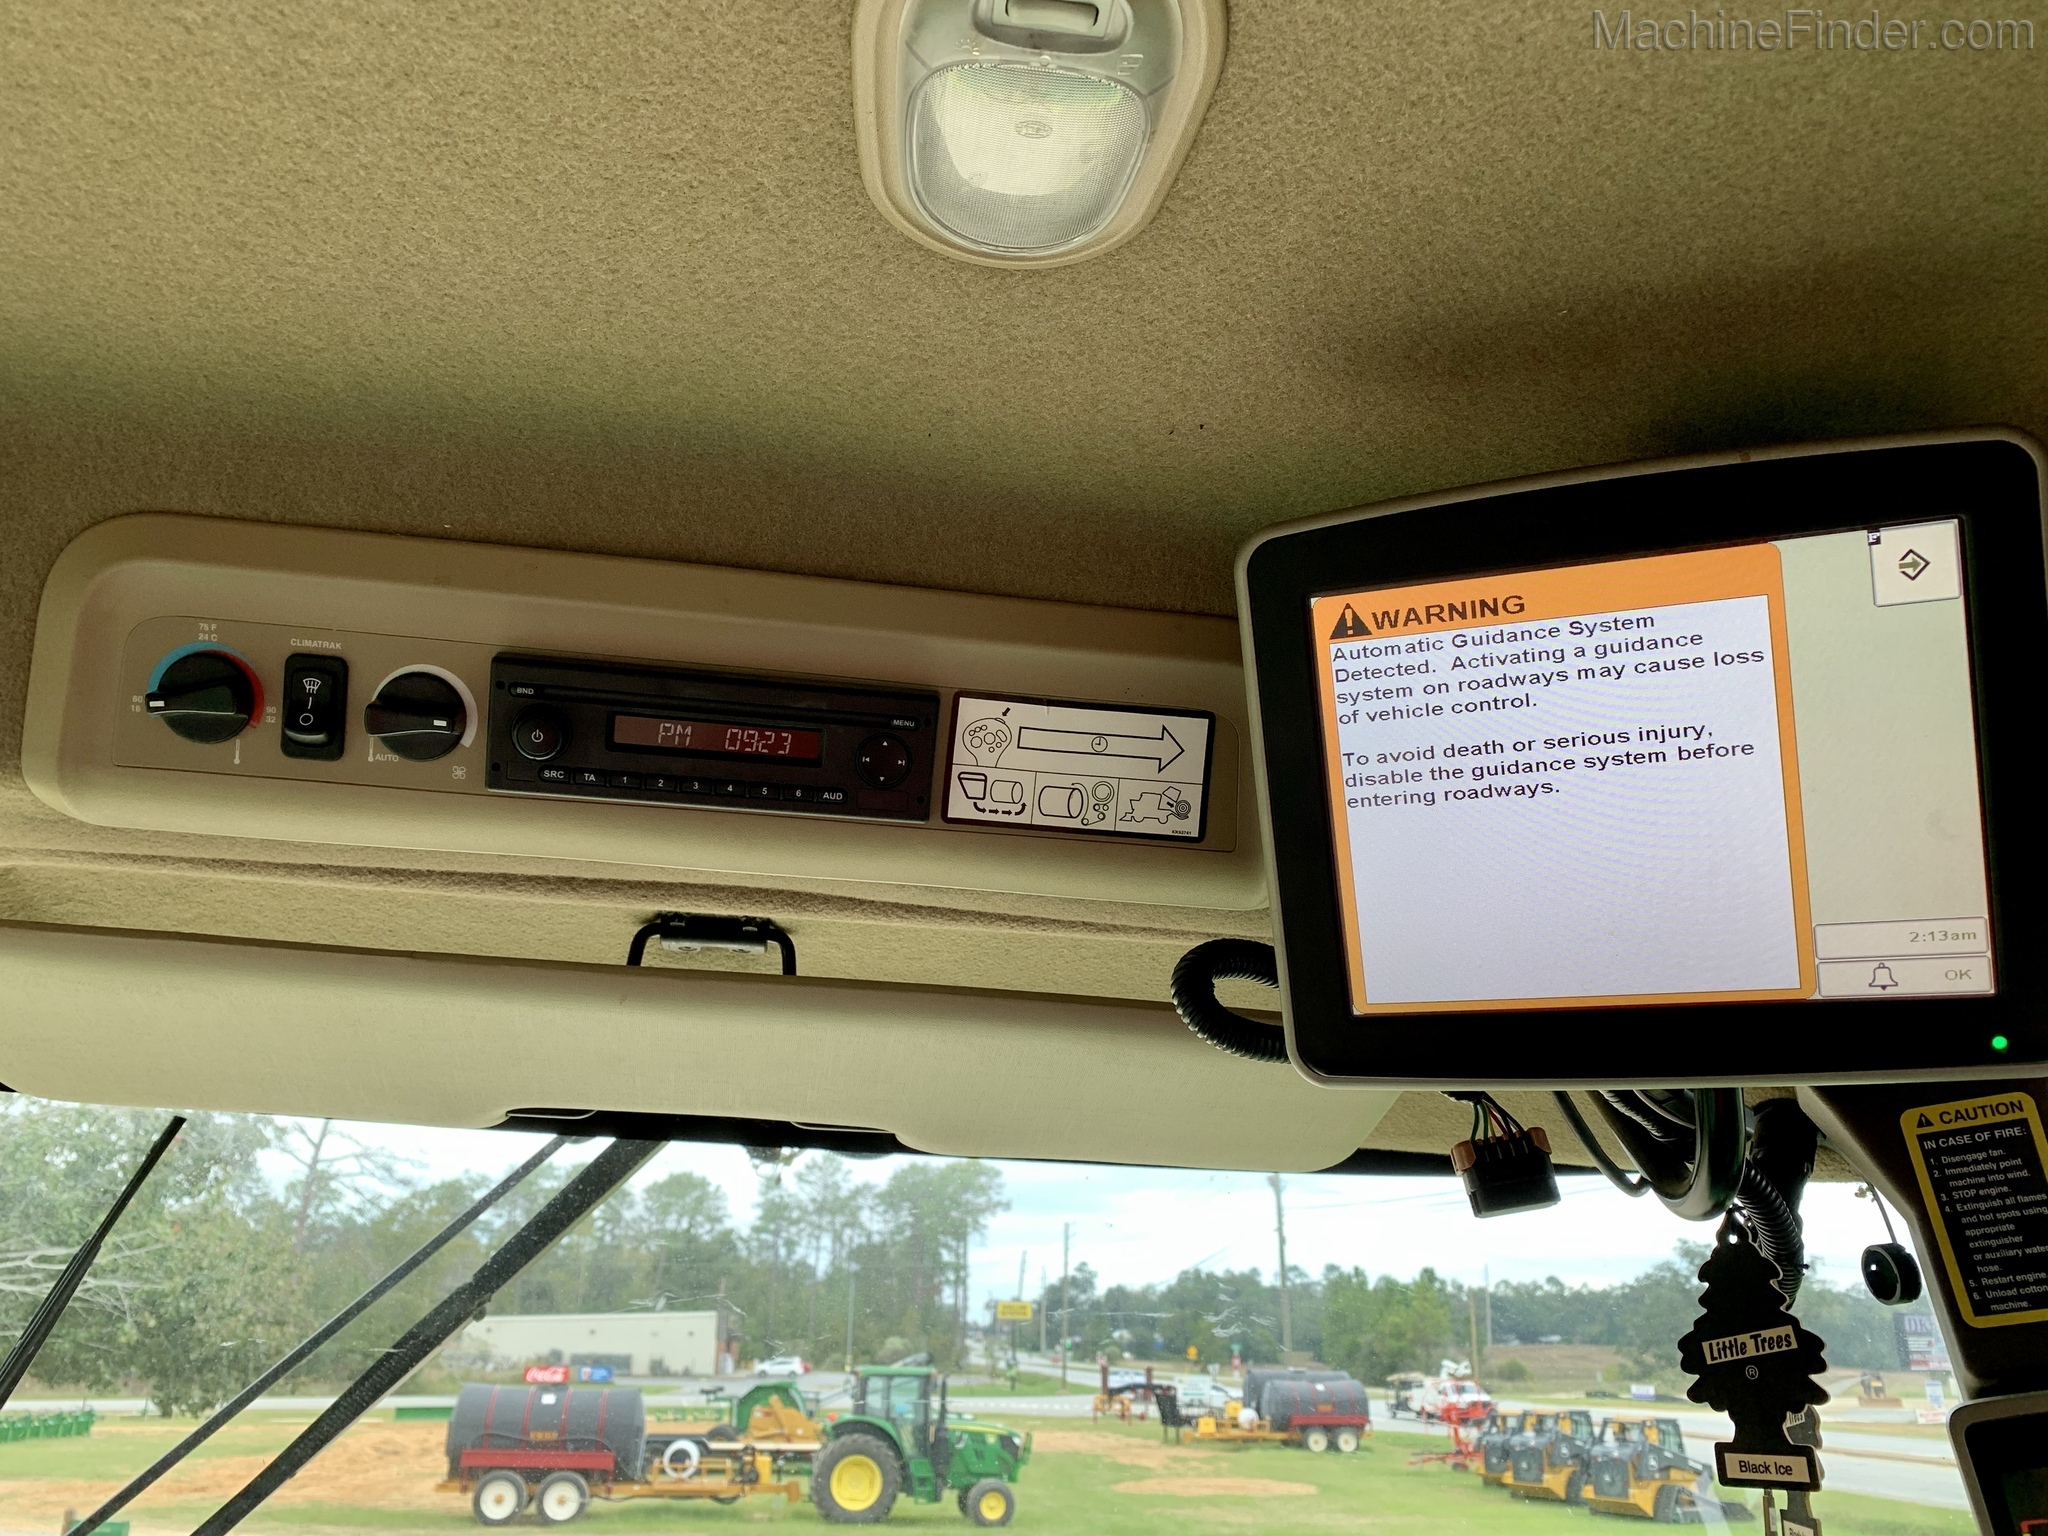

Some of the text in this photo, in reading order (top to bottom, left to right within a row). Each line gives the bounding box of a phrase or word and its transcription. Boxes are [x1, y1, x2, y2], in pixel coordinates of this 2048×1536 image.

[1372, 595, 1525, 630] WARNING
[199, 623, 209, 631] 75
[199, 633, 218, 642] 24 C
[290, 638, 342, 650] CLIMATRAK
[1333, 616, 1655, 662] Automatic Guidance System
[1335, 633, 1704, 683] Detected. Activating a guidance
[1336, 649, 1764, 707] system on roadways may cause loss
[516, 687, 534, 695] BND
[266, 706, 277, 714] 90
[1338, 692, 1537, 725] of vehicle control.
[893, 718, 915, 727] MENU
[658, 722, 692, 746] PM
[1343, 724, 1713, 767] To avoid death or serious injury,
[375, 754, 399, 762] AUTO
[1345, 742, 1755, 787] disable the guidance system before
[543, 769, 843, 801] SRC TA 1 2 3 4 5 6 AUD
[1347, 781, 1560, 809] entering roadways.
[1909, 930, 1977, 943] 2:13am
[1944, 969, 1972, 981] OK
[1939, 1100, 2024, 1124] CAUTION
[1923, 1126, 2027, 1150] IN CASE OF FIRE:
[1941, 1150, 1987, 1164] Disengage
[1988, 1148, 2006, 1157] fan.
[1945, 1161, 1997, 1176] Immediately
[1999, 1158, 2023, 1169] point
[1949, 1169, 2031, 1188] machine into wind.
[1952, 1189, 1977, 1200] STOP
[1980, 1185, 2012, 1196] engine.
[1956, 1199, 2003, 1212] Extinguish
[2005, 1195, 2016, 1204] all
[2017, 1192, 2047, 1204] flames
[1961, 1206, 2048, 1224] and hot spots using
[1965, 1223, 2015, 1237] appropriate
[1969, 1235, 2024, 1249] extinguisher
[1973, 1253, 1983, 1261] or
[1985, 1246, 2022, 1259] auxiliary
[1977, 1263, 2003, 1273] hose.
[1981, 1275, 2013, 1286] Restart
[1985, 1286, 2017, 1299] Unload
[2020, 1283, 2048, 1295] cotton
[1990, 1300, 2032, 1311] machine.
[1708, 1332, 1792, 1362] Little Trees
[1739, 1460, 1793, 1476] Black Ice
